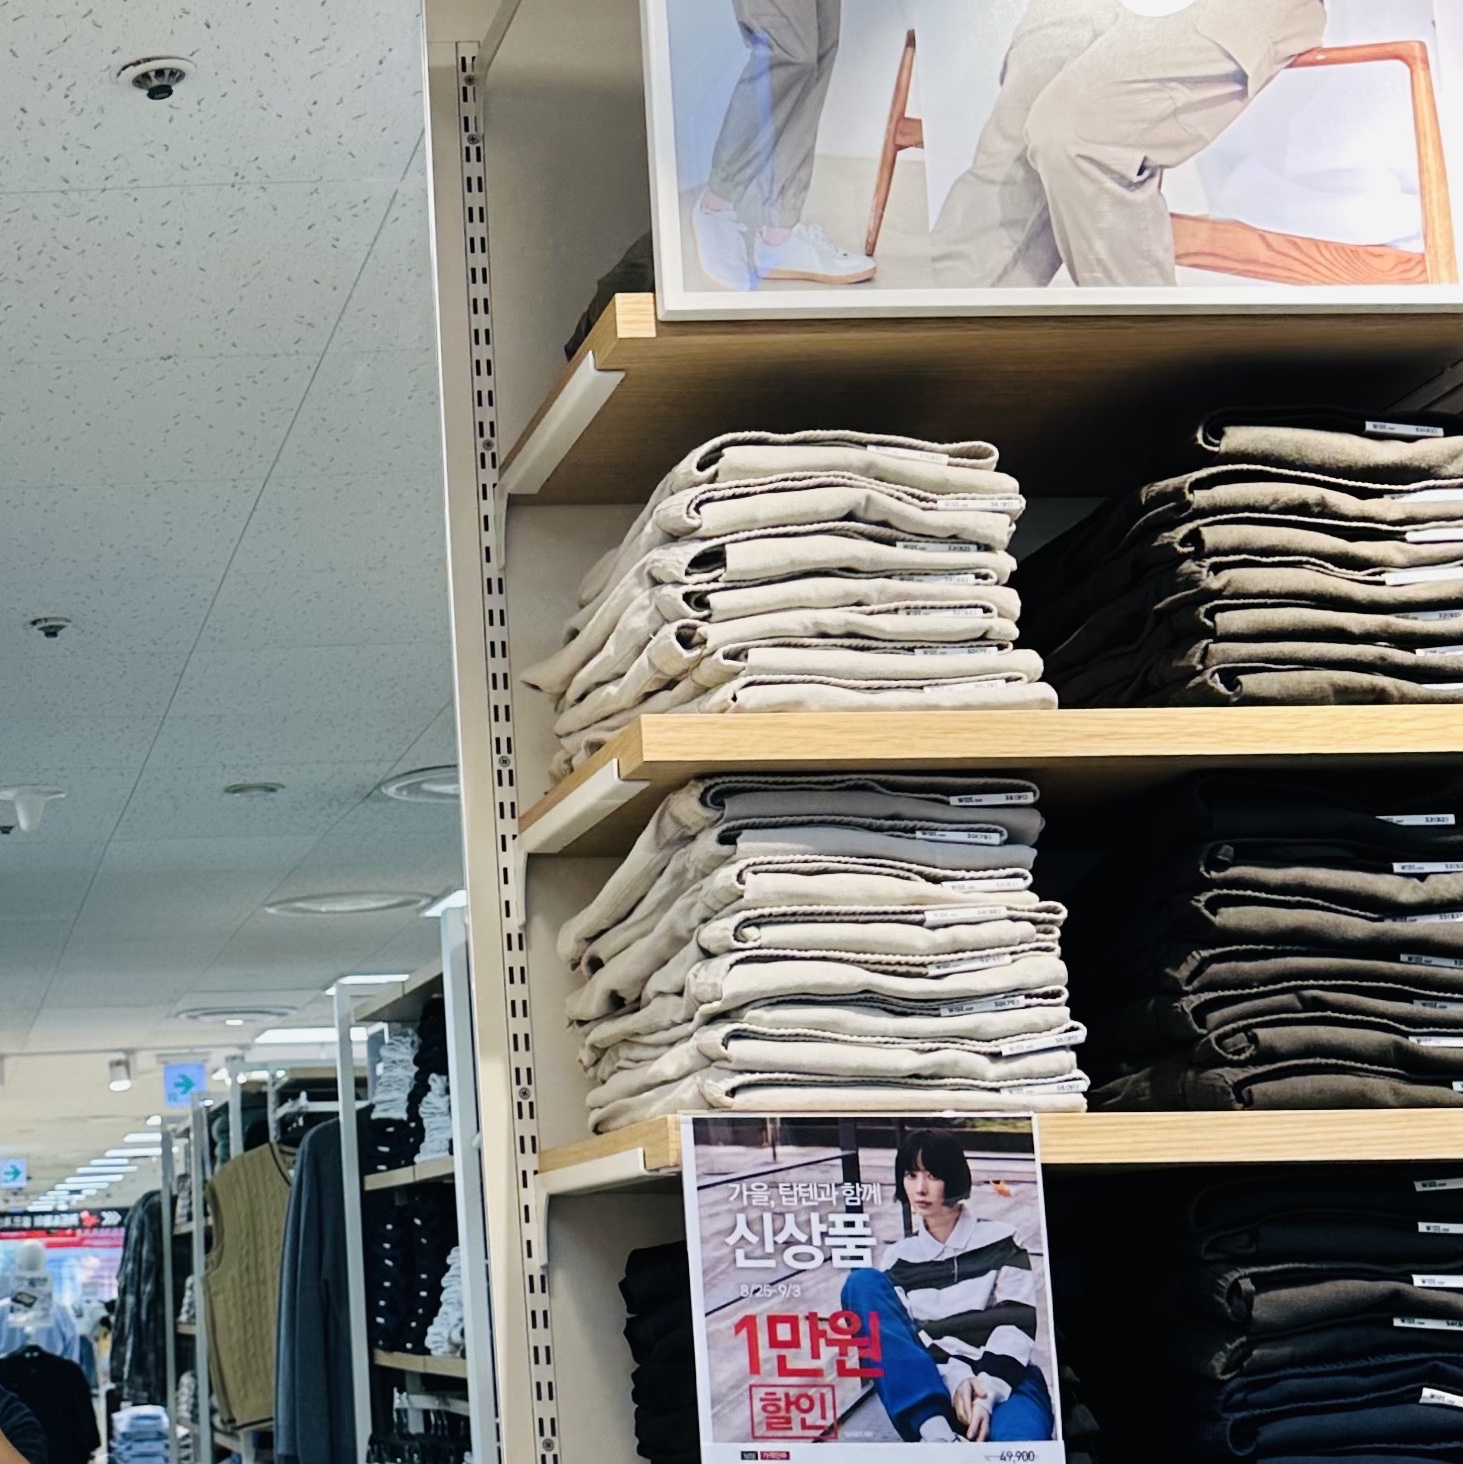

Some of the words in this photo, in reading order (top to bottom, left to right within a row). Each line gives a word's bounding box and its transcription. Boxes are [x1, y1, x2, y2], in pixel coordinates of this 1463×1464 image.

[728, 1181, 775, 1208] 가을,
[778, 1182, 837, 1206] 탑텐과
[841, 1182, 882, 1206] 함께
[725, 1211, 877, 1270] 신상품
[734, 1310, 884, 1378] 1만원
[759, 1391, 828, 1431] 할인
[999, 1450, 1036, 1464] 49,900
